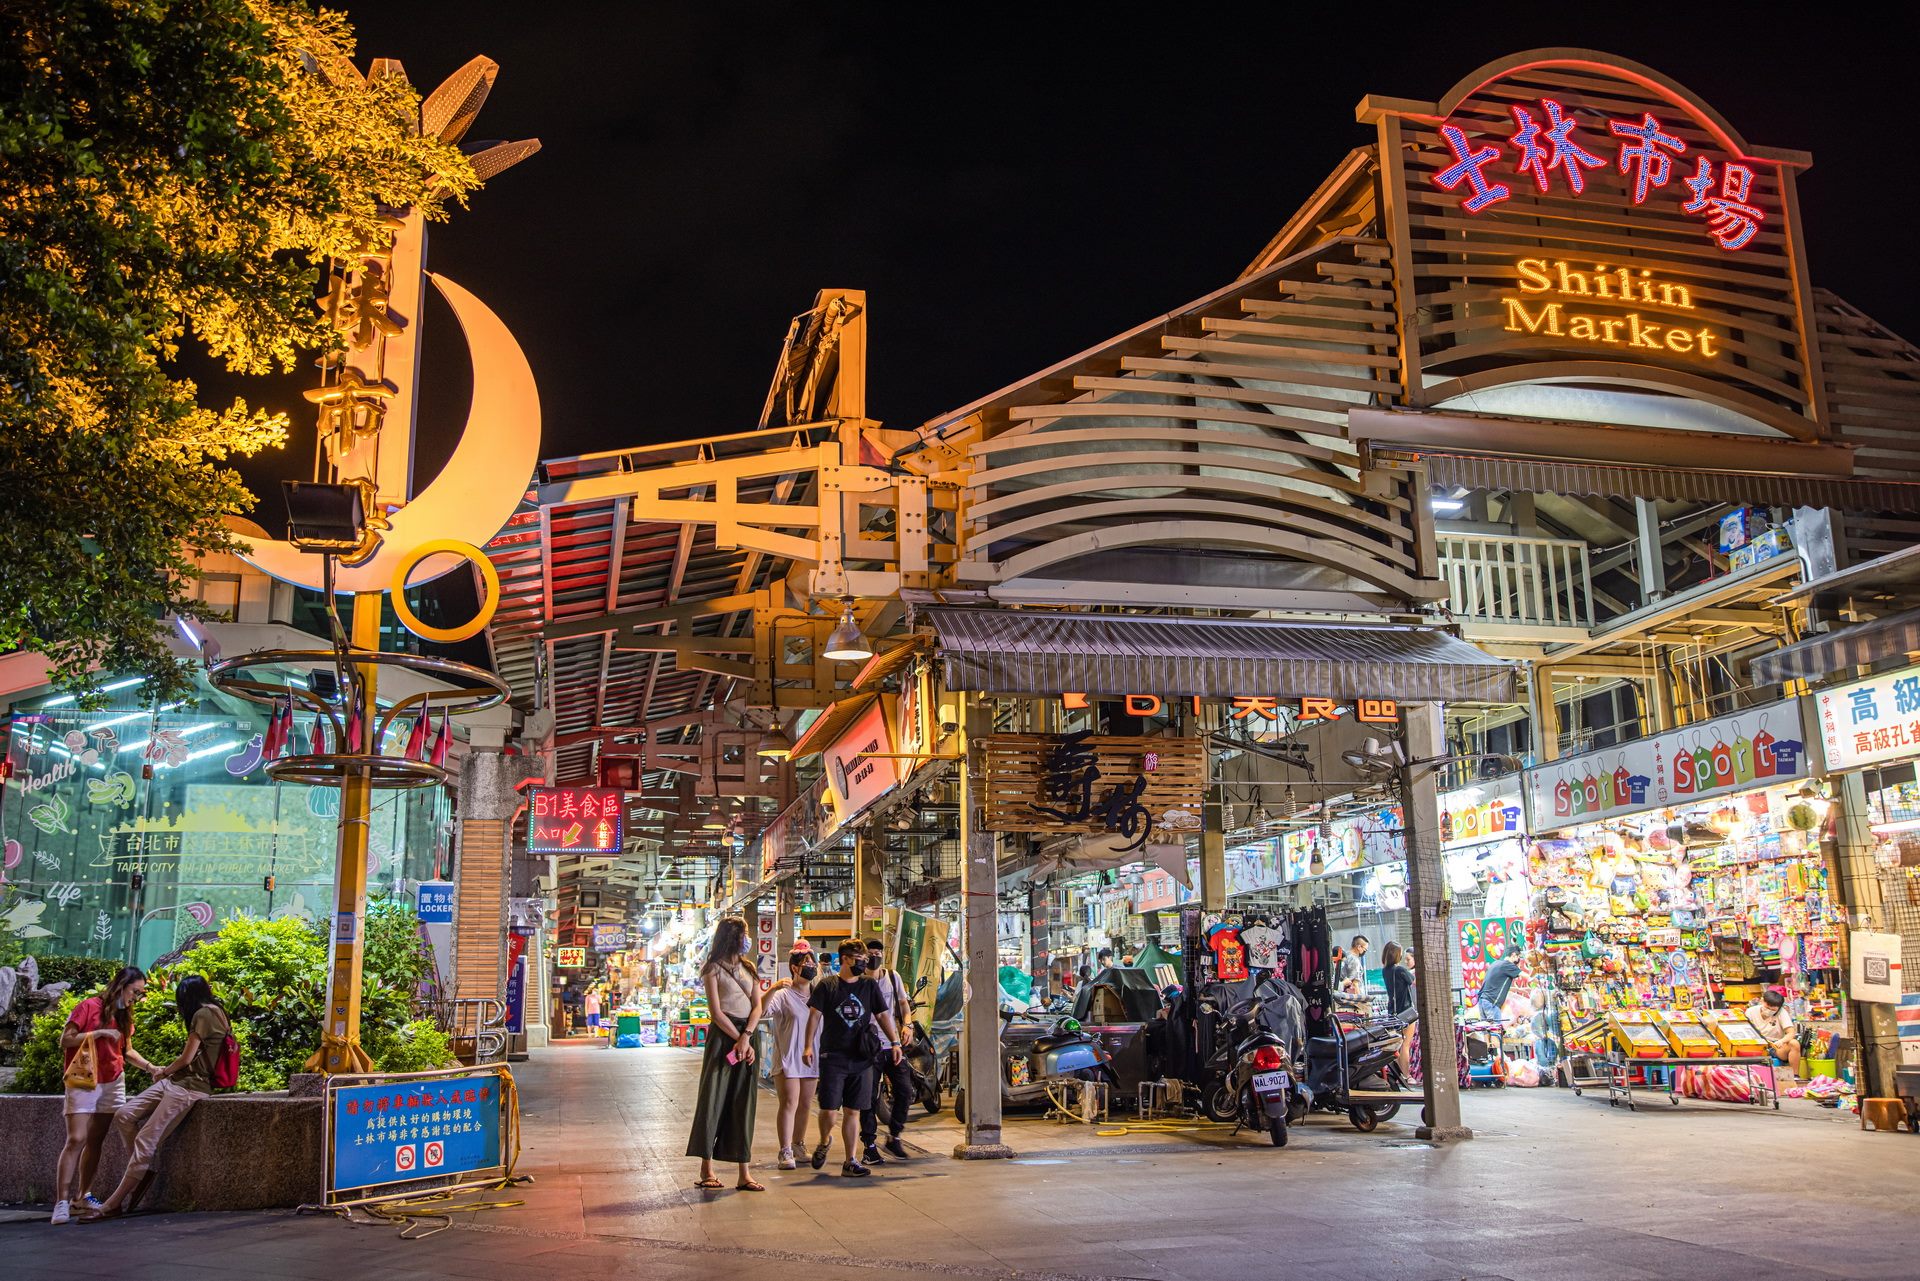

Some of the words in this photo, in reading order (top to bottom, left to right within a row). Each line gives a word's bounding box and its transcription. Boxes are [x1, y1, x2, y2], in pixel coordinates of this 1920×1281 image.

[1432, 97, 1765, 251] 士林市場
[1515, 259, 1696, 309] Shilin
[1501, 297, 1719, 358] Market
[20, 760, 77, 797] Health
[1676, 741, 1770, 790] Sport
[535, 792, 619, 818] B1美食區
[1557, 775, 1627, 814] Sport
[534, 827, 560, 840] 入口
[116, 862, 148, 873] TAIPEI
[151, 862, 175, 873] CITY
[177, 863, 215, 873] SHI-LIN
[218, 864, 254, 873] PUBLIC
[257, 864, 297, 874] MARKET
[47, 881, 81, 907] Life
[1254, 1075, 1286, 1088] NAL-9027
[354, 1120, 482, 1146] 士林市場非常感謝您的配合
